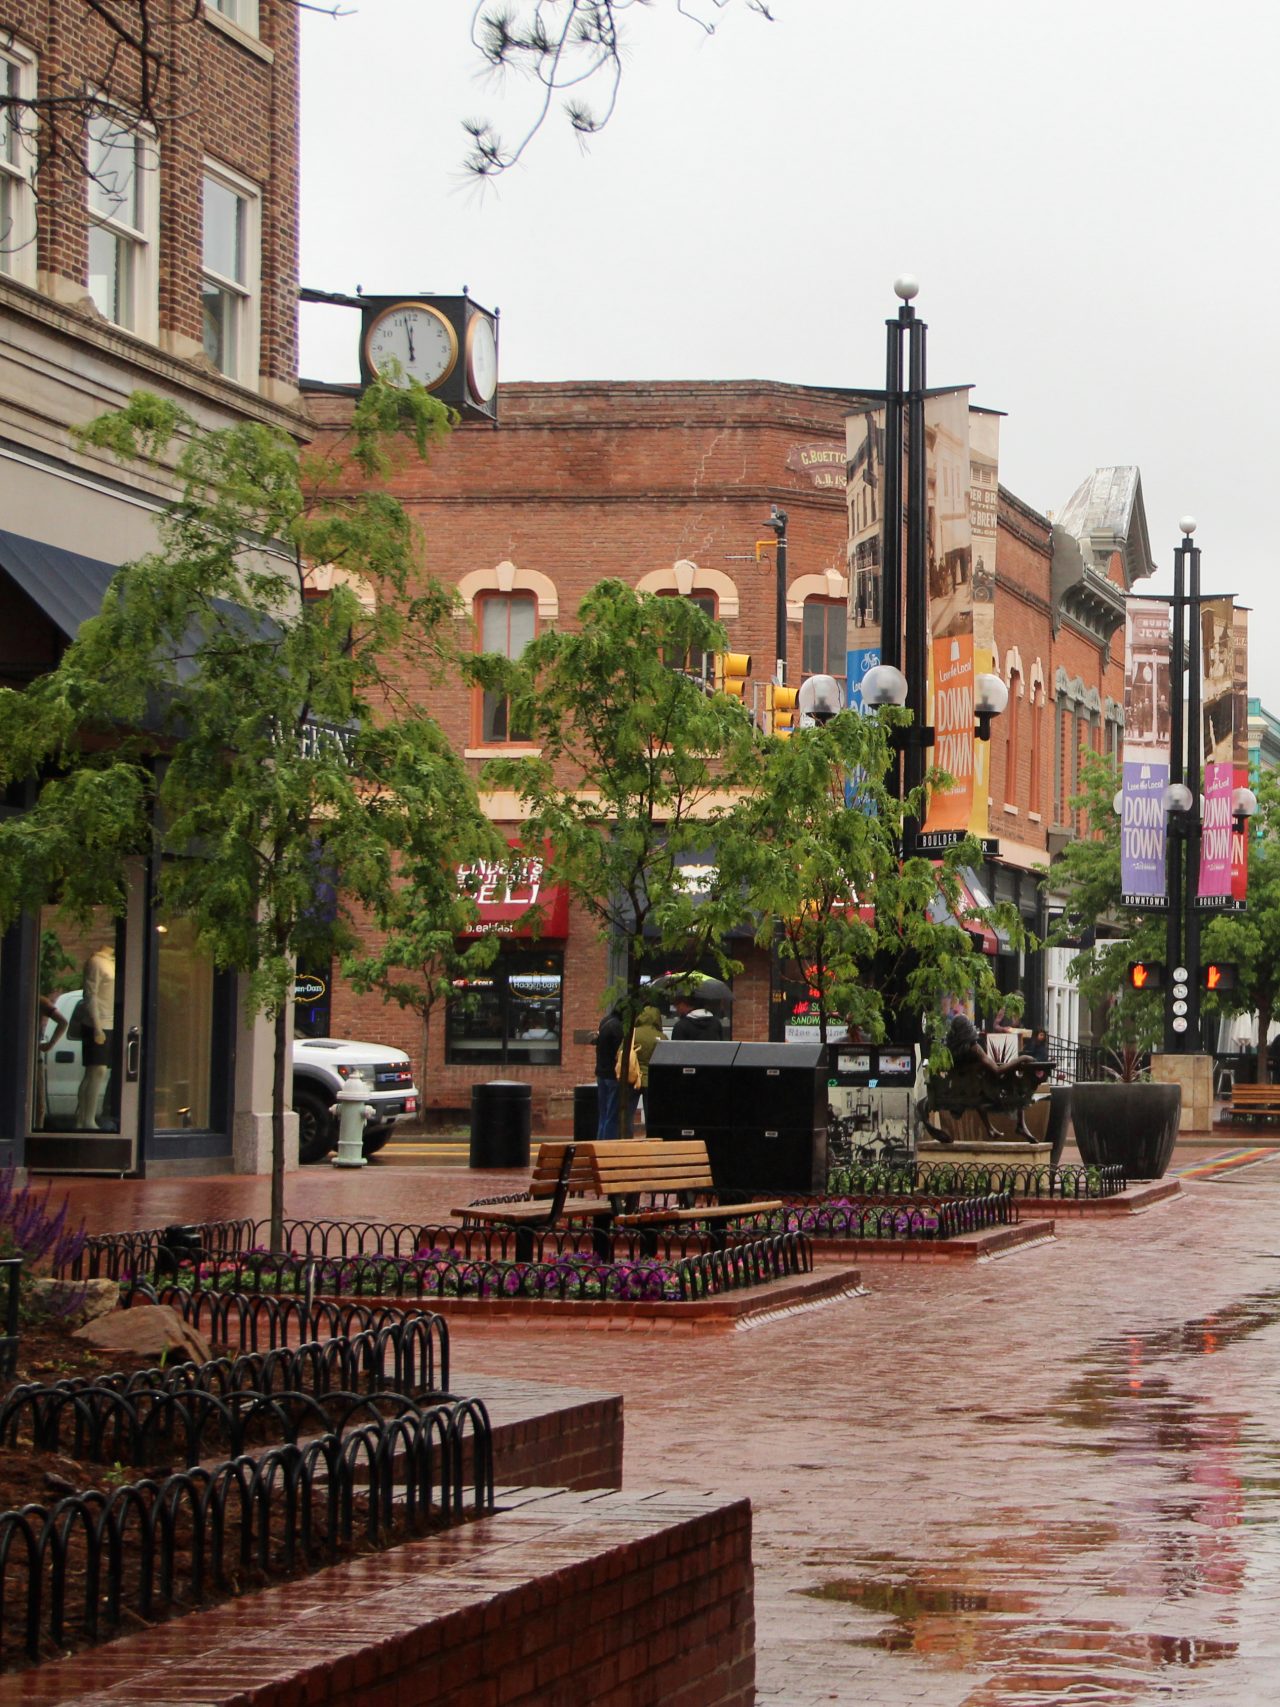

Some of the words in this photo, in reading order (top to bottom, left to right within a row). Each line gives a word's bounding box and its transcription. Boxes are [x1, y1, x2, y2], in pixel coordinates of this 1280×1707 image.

[938, 686, 972, 732] DOWN
[937, 732, 972, 777] TOWN
[1124, 797, 1164, 828] DOWN
[1203, 797, 1230, 828] DOWN
[922, 834, 957, 847] BOULDER
[1123, 827, 1163, 860] TOWN
[1202, 828, 1230, 861] TOWN
[1125, 896, 1165, 906] DOWNTOWN
[1199, 896, 1226, 906] BOULDER
